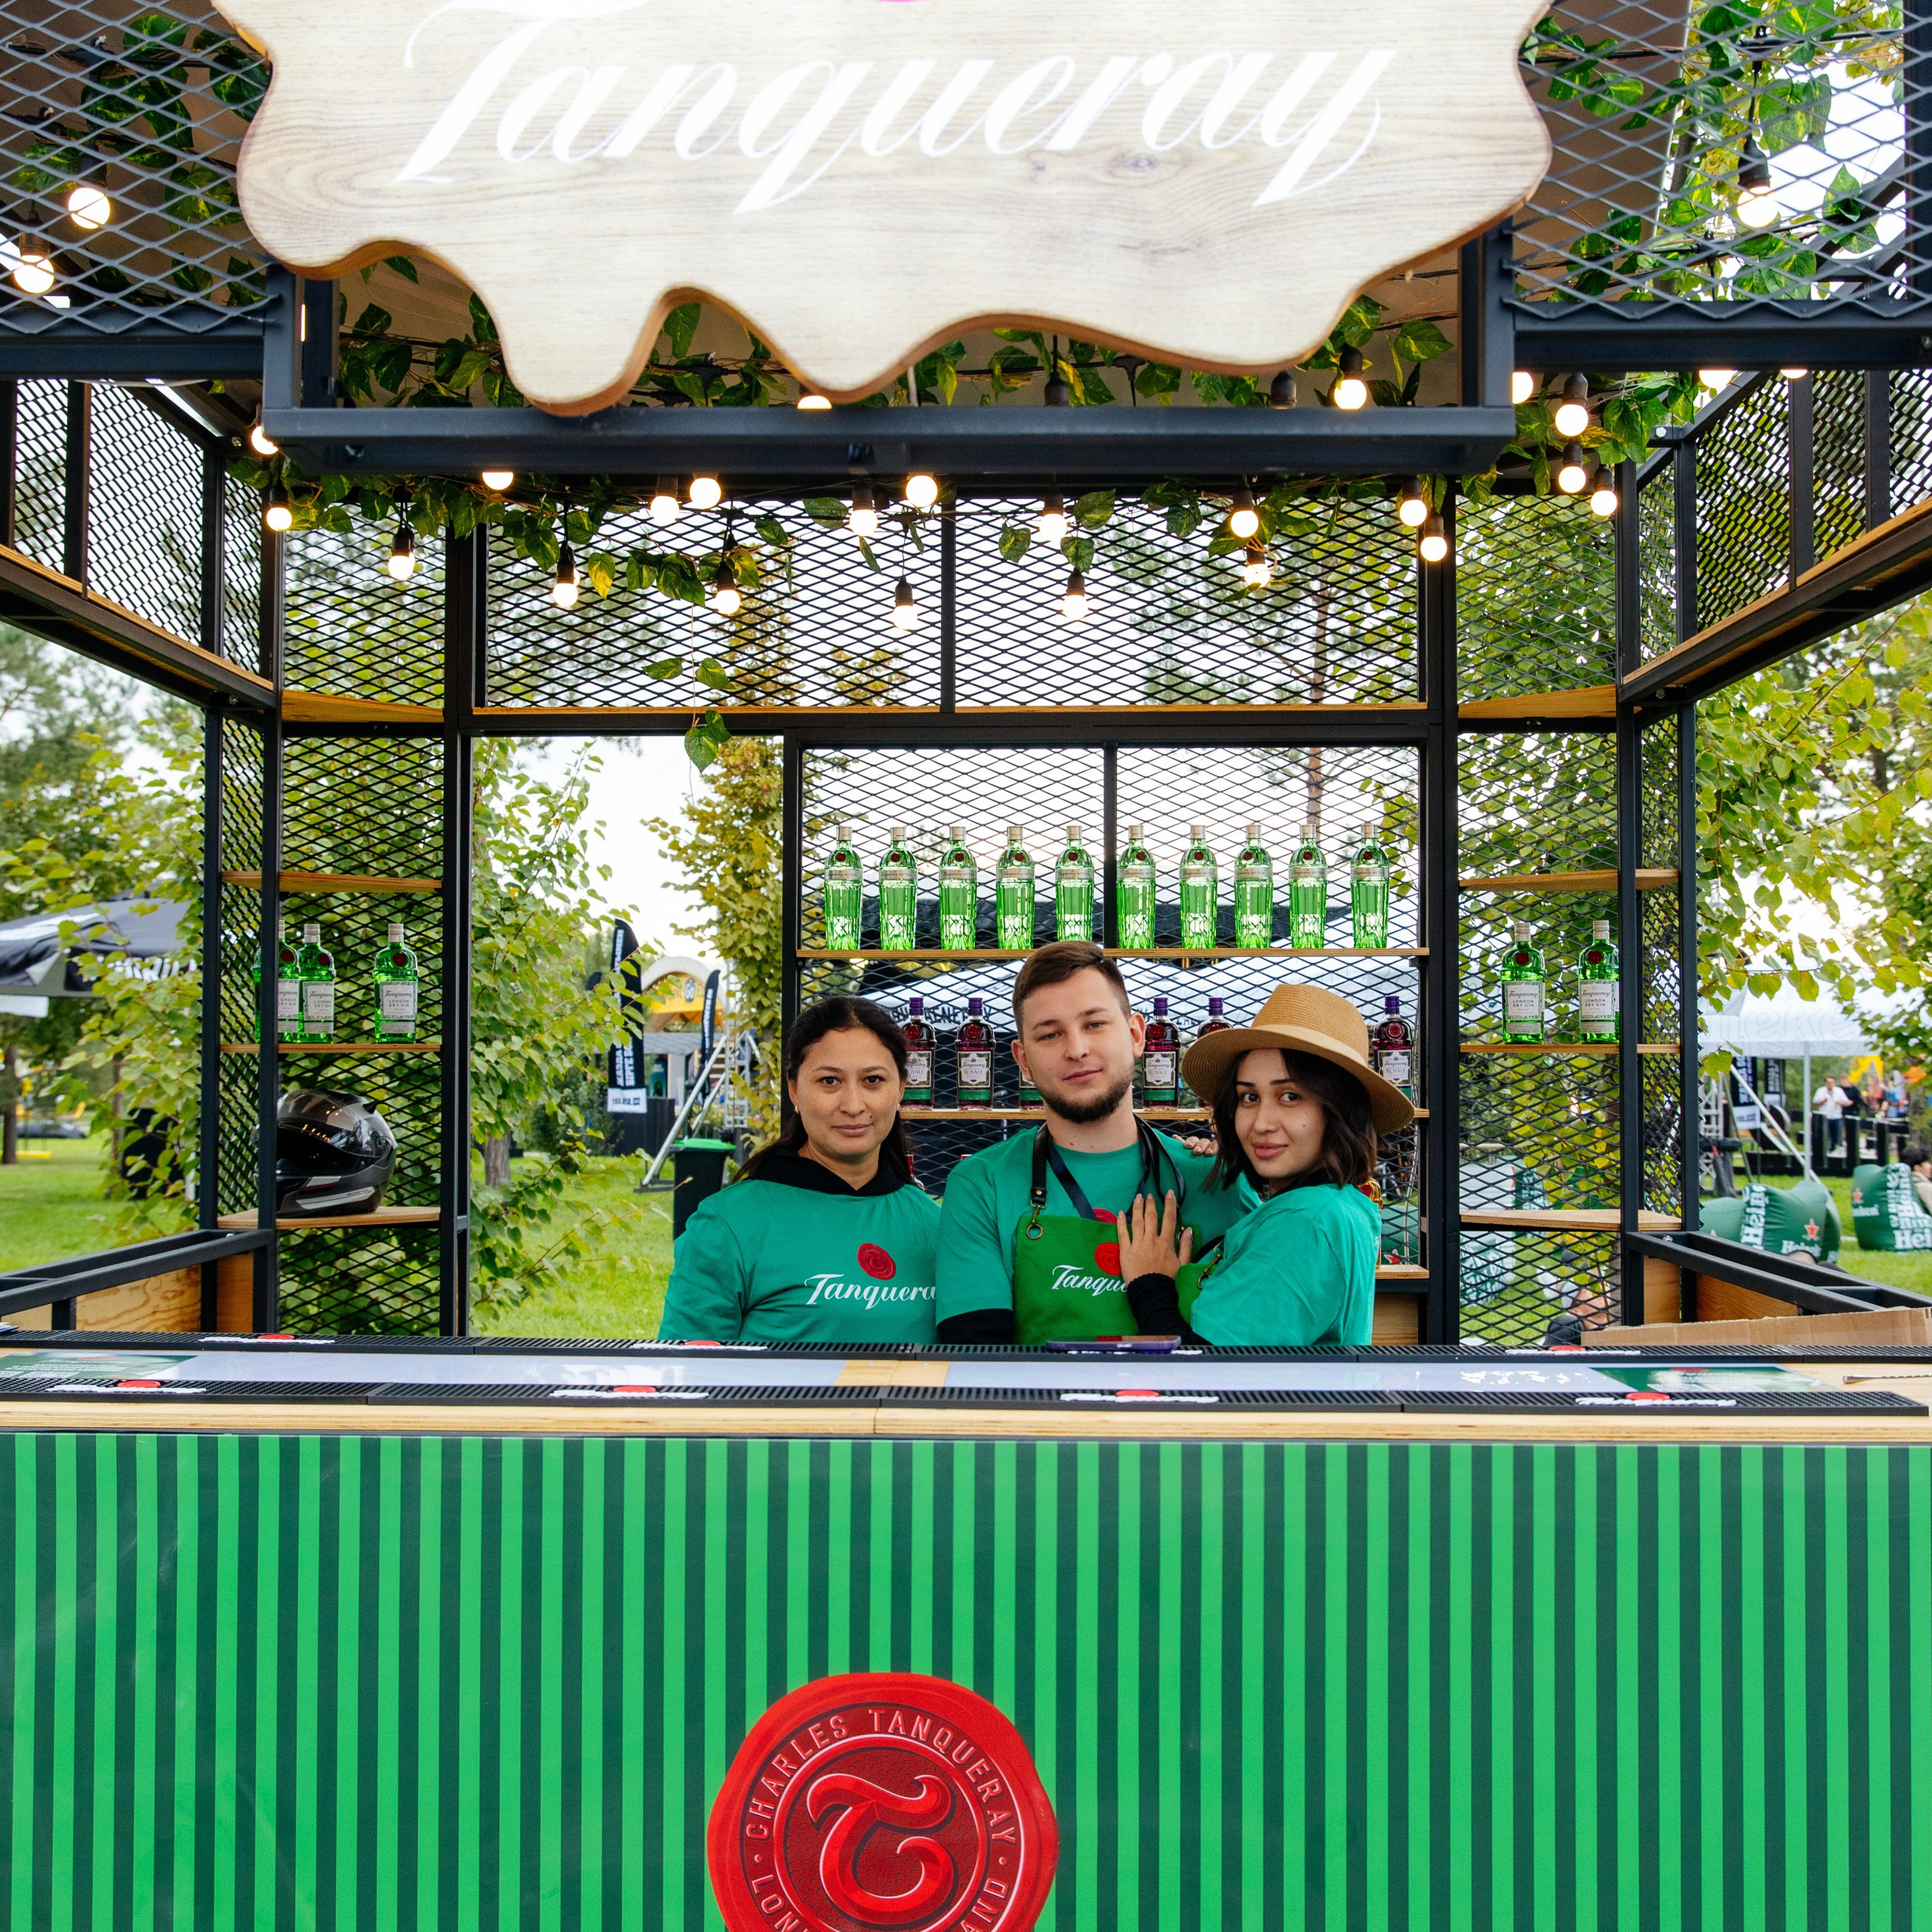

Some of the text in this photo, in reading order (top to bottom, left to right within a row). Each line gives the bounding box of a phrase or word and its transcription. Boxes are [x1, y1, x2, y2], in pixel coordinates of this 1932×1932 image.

[393, 0, 1396, 214] Tanqueray
[804, 1274, 936, 1310] Tanquera
[746, 1709, 1017, 1846] CHARLES TANQUERAY
[752, 1874, 807, 1932] LON
